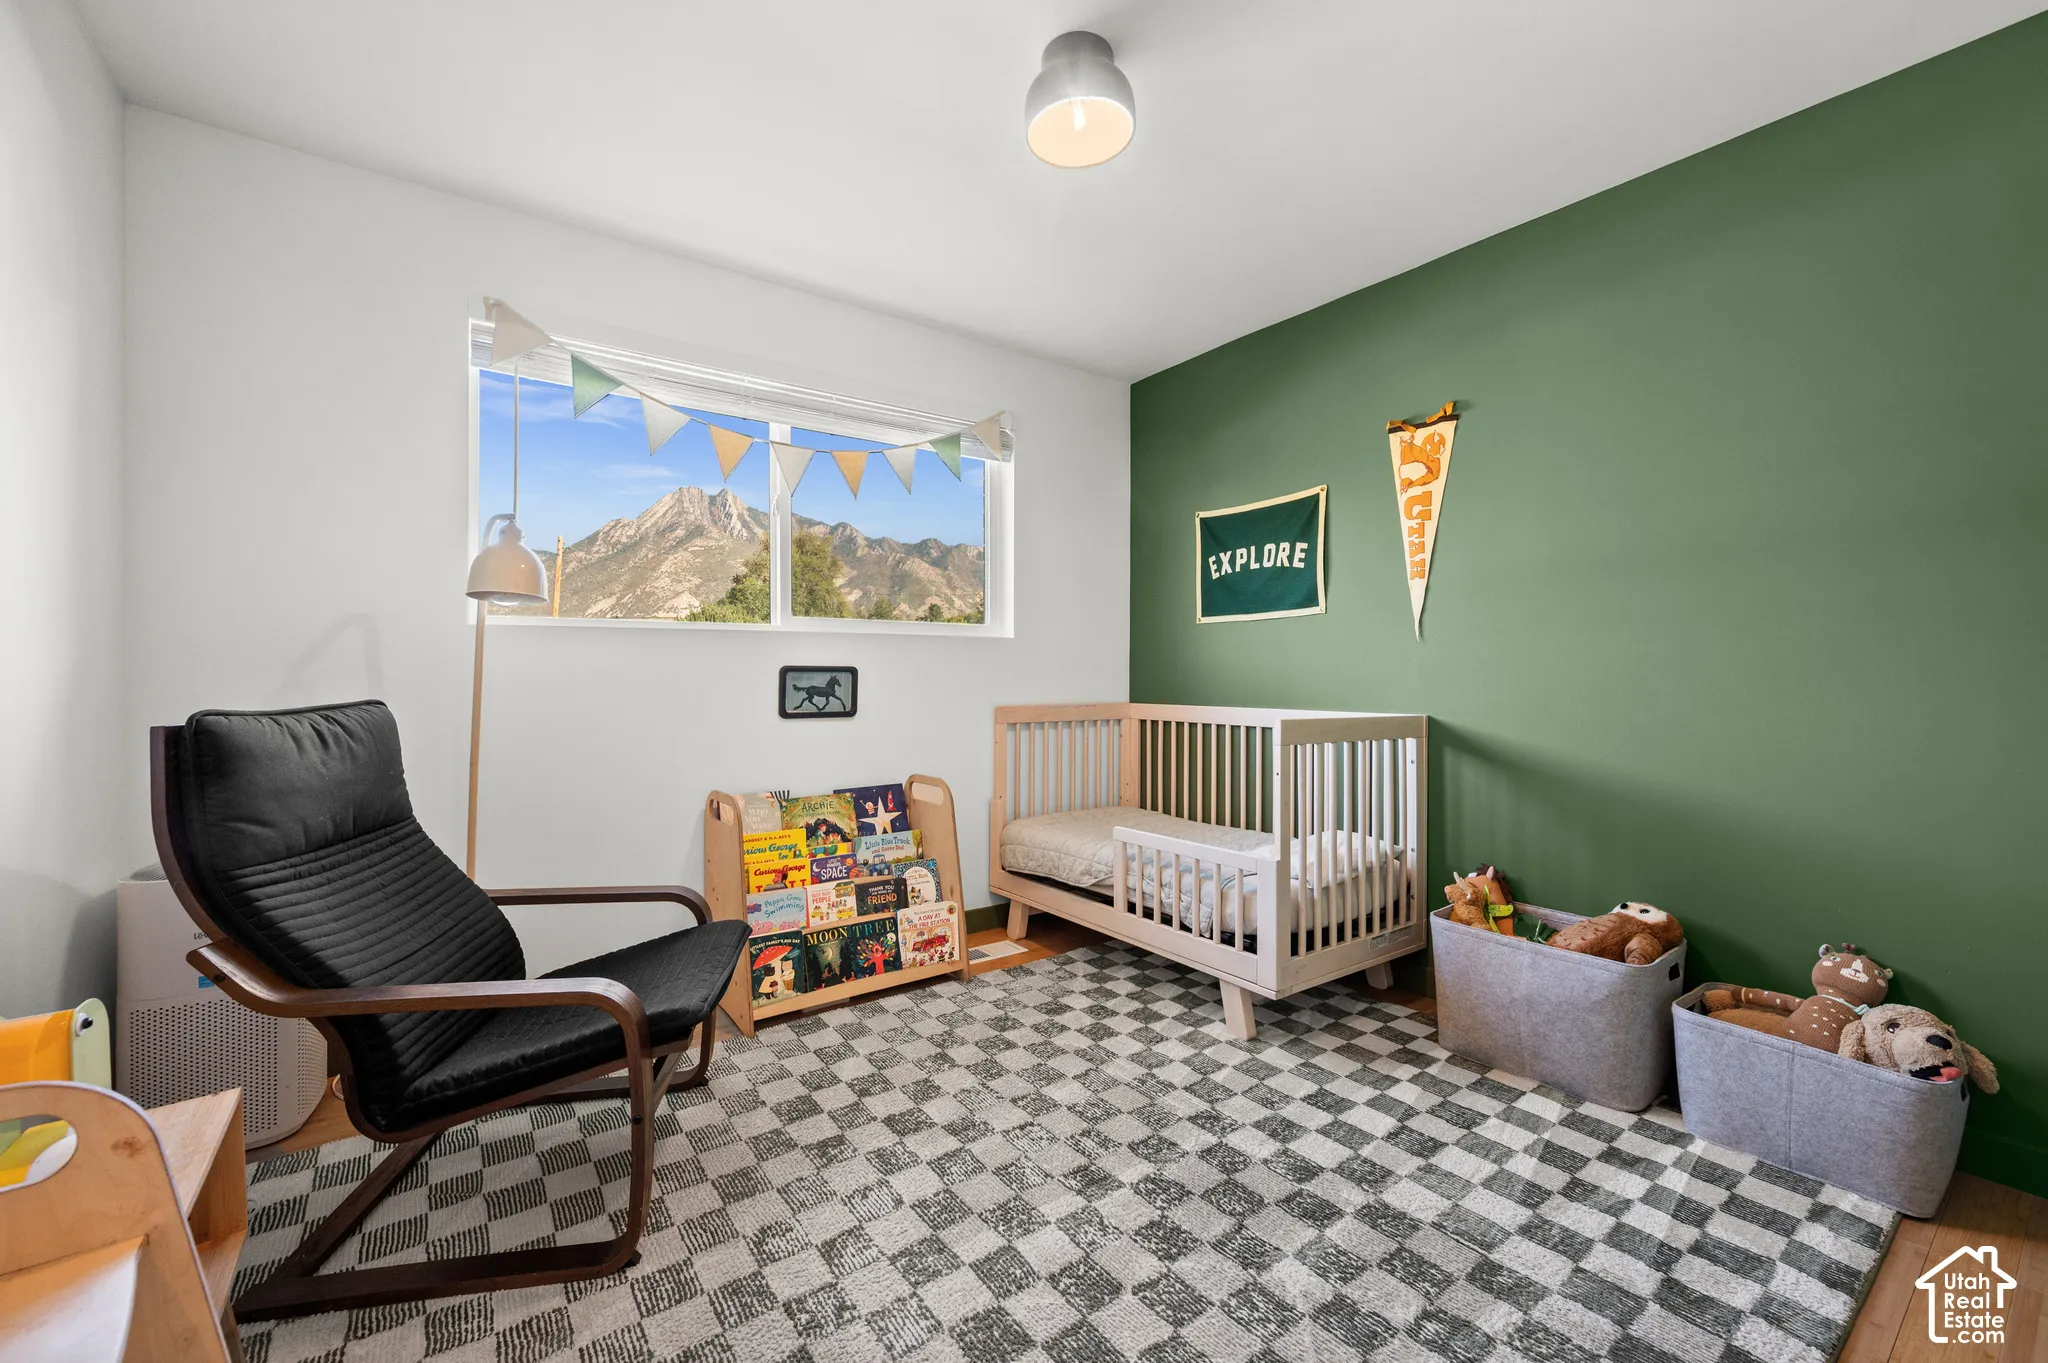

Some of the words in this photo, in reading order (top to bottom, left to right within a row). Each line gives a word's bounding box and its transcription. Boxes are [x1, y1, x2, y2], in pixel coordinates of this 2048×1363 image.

[1404, 491, 1433, 581] UTAH
[1208, 542, 1309, 580] EXPLORE
[768, 843, 798, 853] George
[865, 841, 881, 851] Little
[881, 837, 894, 847] Blue
[893, 836, 911, 845] Truck
[754, 867, 782, 877] Curious
[781, 864, 806, 873] George
[821, 866, 848, 881] SPACE
[764, 898, 785, 908] Peppa
[786, 893, 802, 902] Goes
[812, 896, 831, 905] PEOPLE
[867, 893, 898, 906] FRIEND
[764, 901, 805, 918] Swimming
[930, 917, 951, 927] STATION
[805, 926, 848, 947] MOON
[853, 918, 895, 938] TREE
